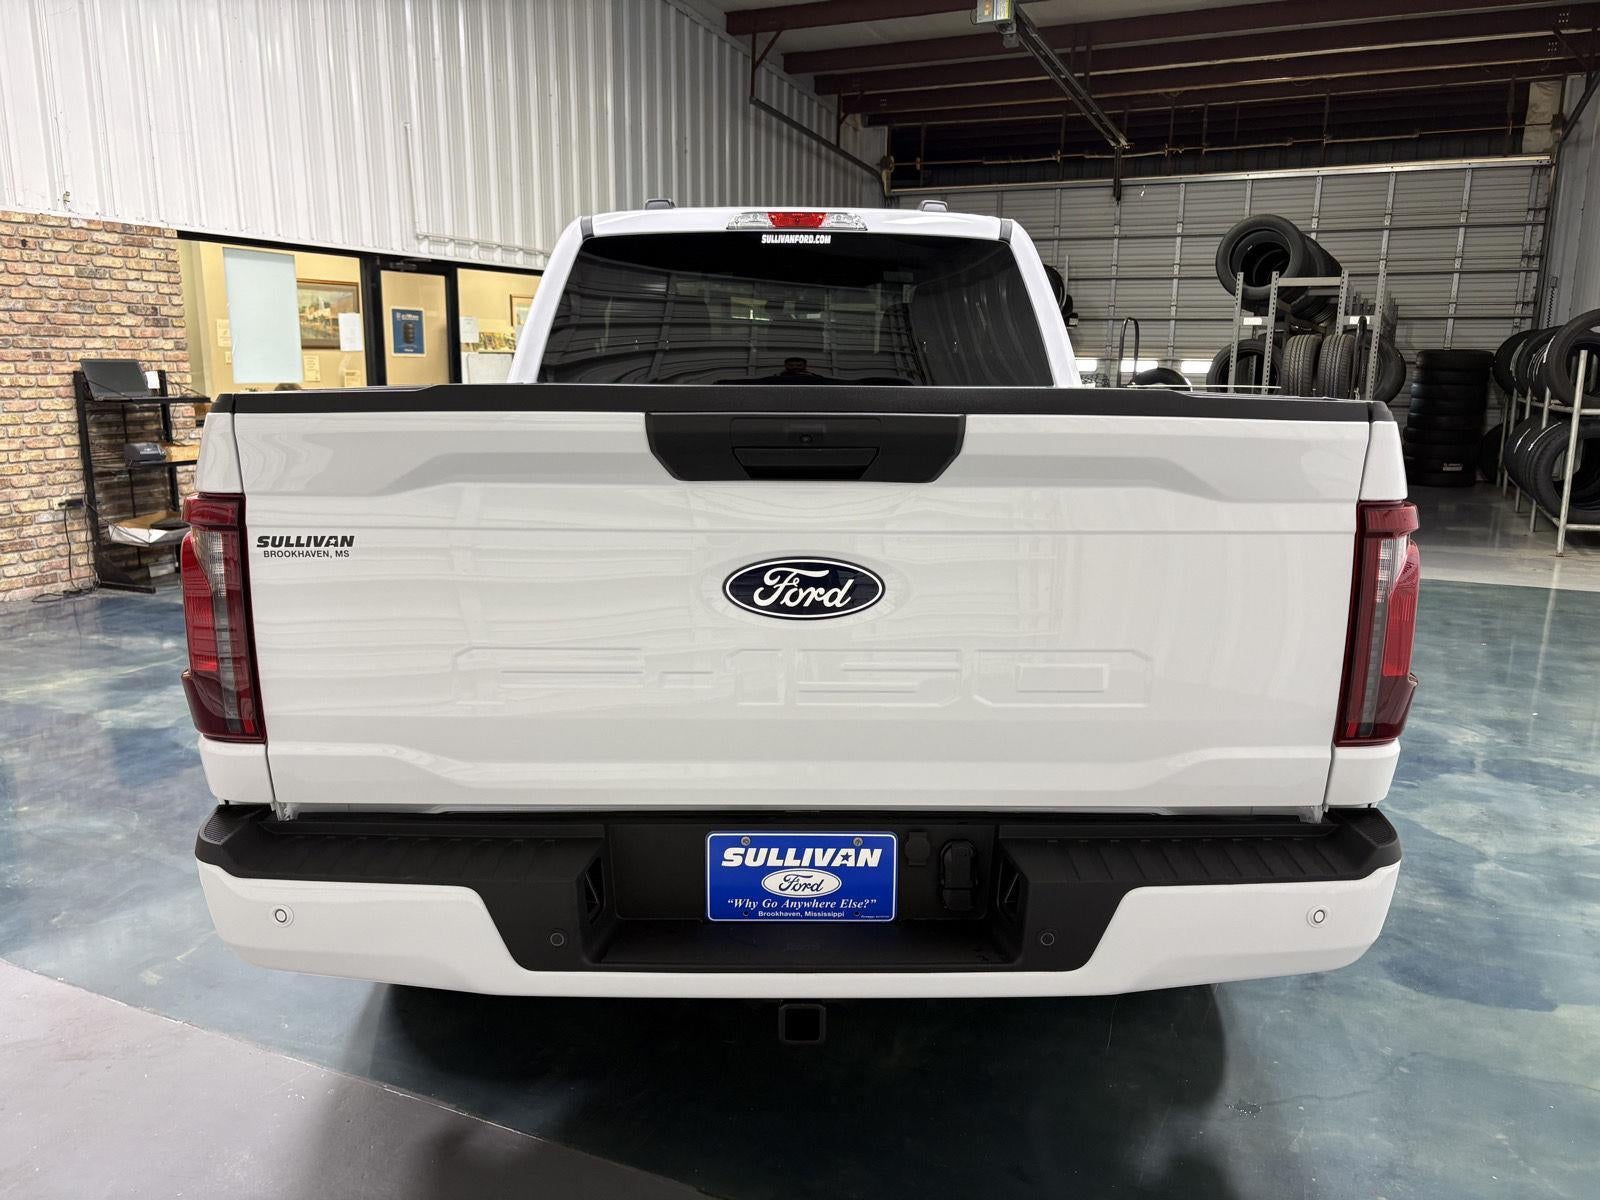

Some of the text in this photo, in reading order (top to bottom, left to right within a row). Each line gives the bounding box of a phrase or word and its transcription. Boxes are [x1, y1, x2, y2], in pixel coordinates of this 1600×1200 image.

[761, 234, 831, 244] SULLIVANFORD.COM
[256, 535, 355, 548] SULLIVAN
[263, 550, 350, 559] BROOKHAVEN, MS
[753, 567, 855, 608] Ford
[452, 647, 1153, 707] F-150
[721, 847, 883, 867] SULLIVAN
[778, 873, 825, 892] Ford
[762, 898, 778, 909] Go
[781, 898, 836, 910] Anywhere
